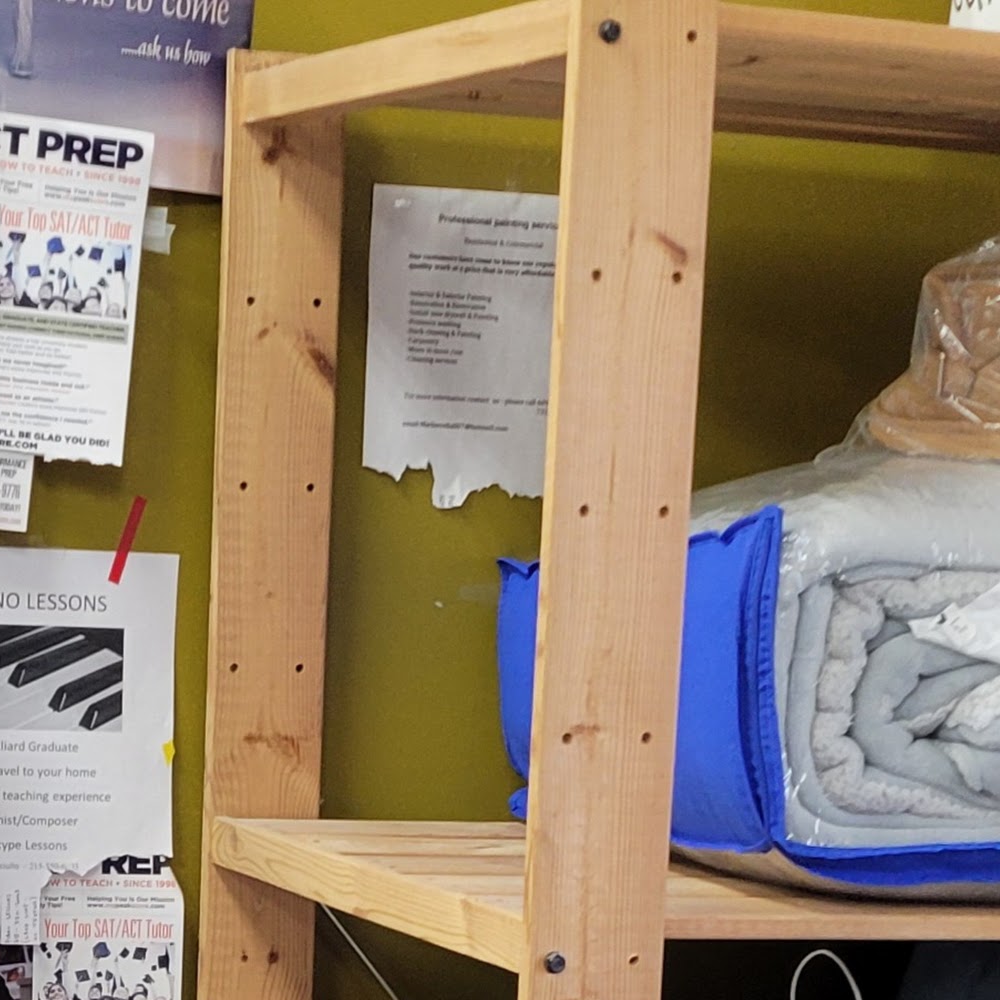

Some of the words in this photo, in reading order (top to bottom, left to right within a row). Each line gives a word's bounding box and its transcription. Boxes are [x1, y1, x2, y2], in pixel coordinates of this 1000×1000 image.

[162, 0, 230, 26] come
[165, 49, 181, 62] us
[184, 38, 211, 66] how
[36, 130, 144, 170] PREP
[22, 162, 37, 173] TO
[40, 164, 73, 178] TEACH
[84, 169, 114, 182] SINCE
[26, 207, 47, 232] Top
[50, 211, 101, 236] SAT/ACT
[103, 216, 132, 241] Tutor
[18, 430, 31, 439] BE
[33, 432, 61, 443] GLAD
[65, 435, 86, 446] YOU
[88, 438, 110, 448] DID!
[27, 593, 108, 612] LESSONS
[28, 741, 79, 753] Graduate
[22, 767, 34, 777] to
[37, 768, 62, 781] your
[65, 767, 97, 778] home
[2, 790, 49, 803] teaching
[52, 792, 111, 804] experience
[25, 840, 68, 851] Lessons
[102, 854, 172, 875] REP
[64, 879, 76, 887] TO
[80, 879, 112, 887] TEACH
[123, 880, 152, 888] SINCE
[45, 919, 69, 938] Your
[72, 919, 91, 940] Top
[95, 919, 142, 938] SAT/ACT
[146, 919, 174, 939] Tutor
